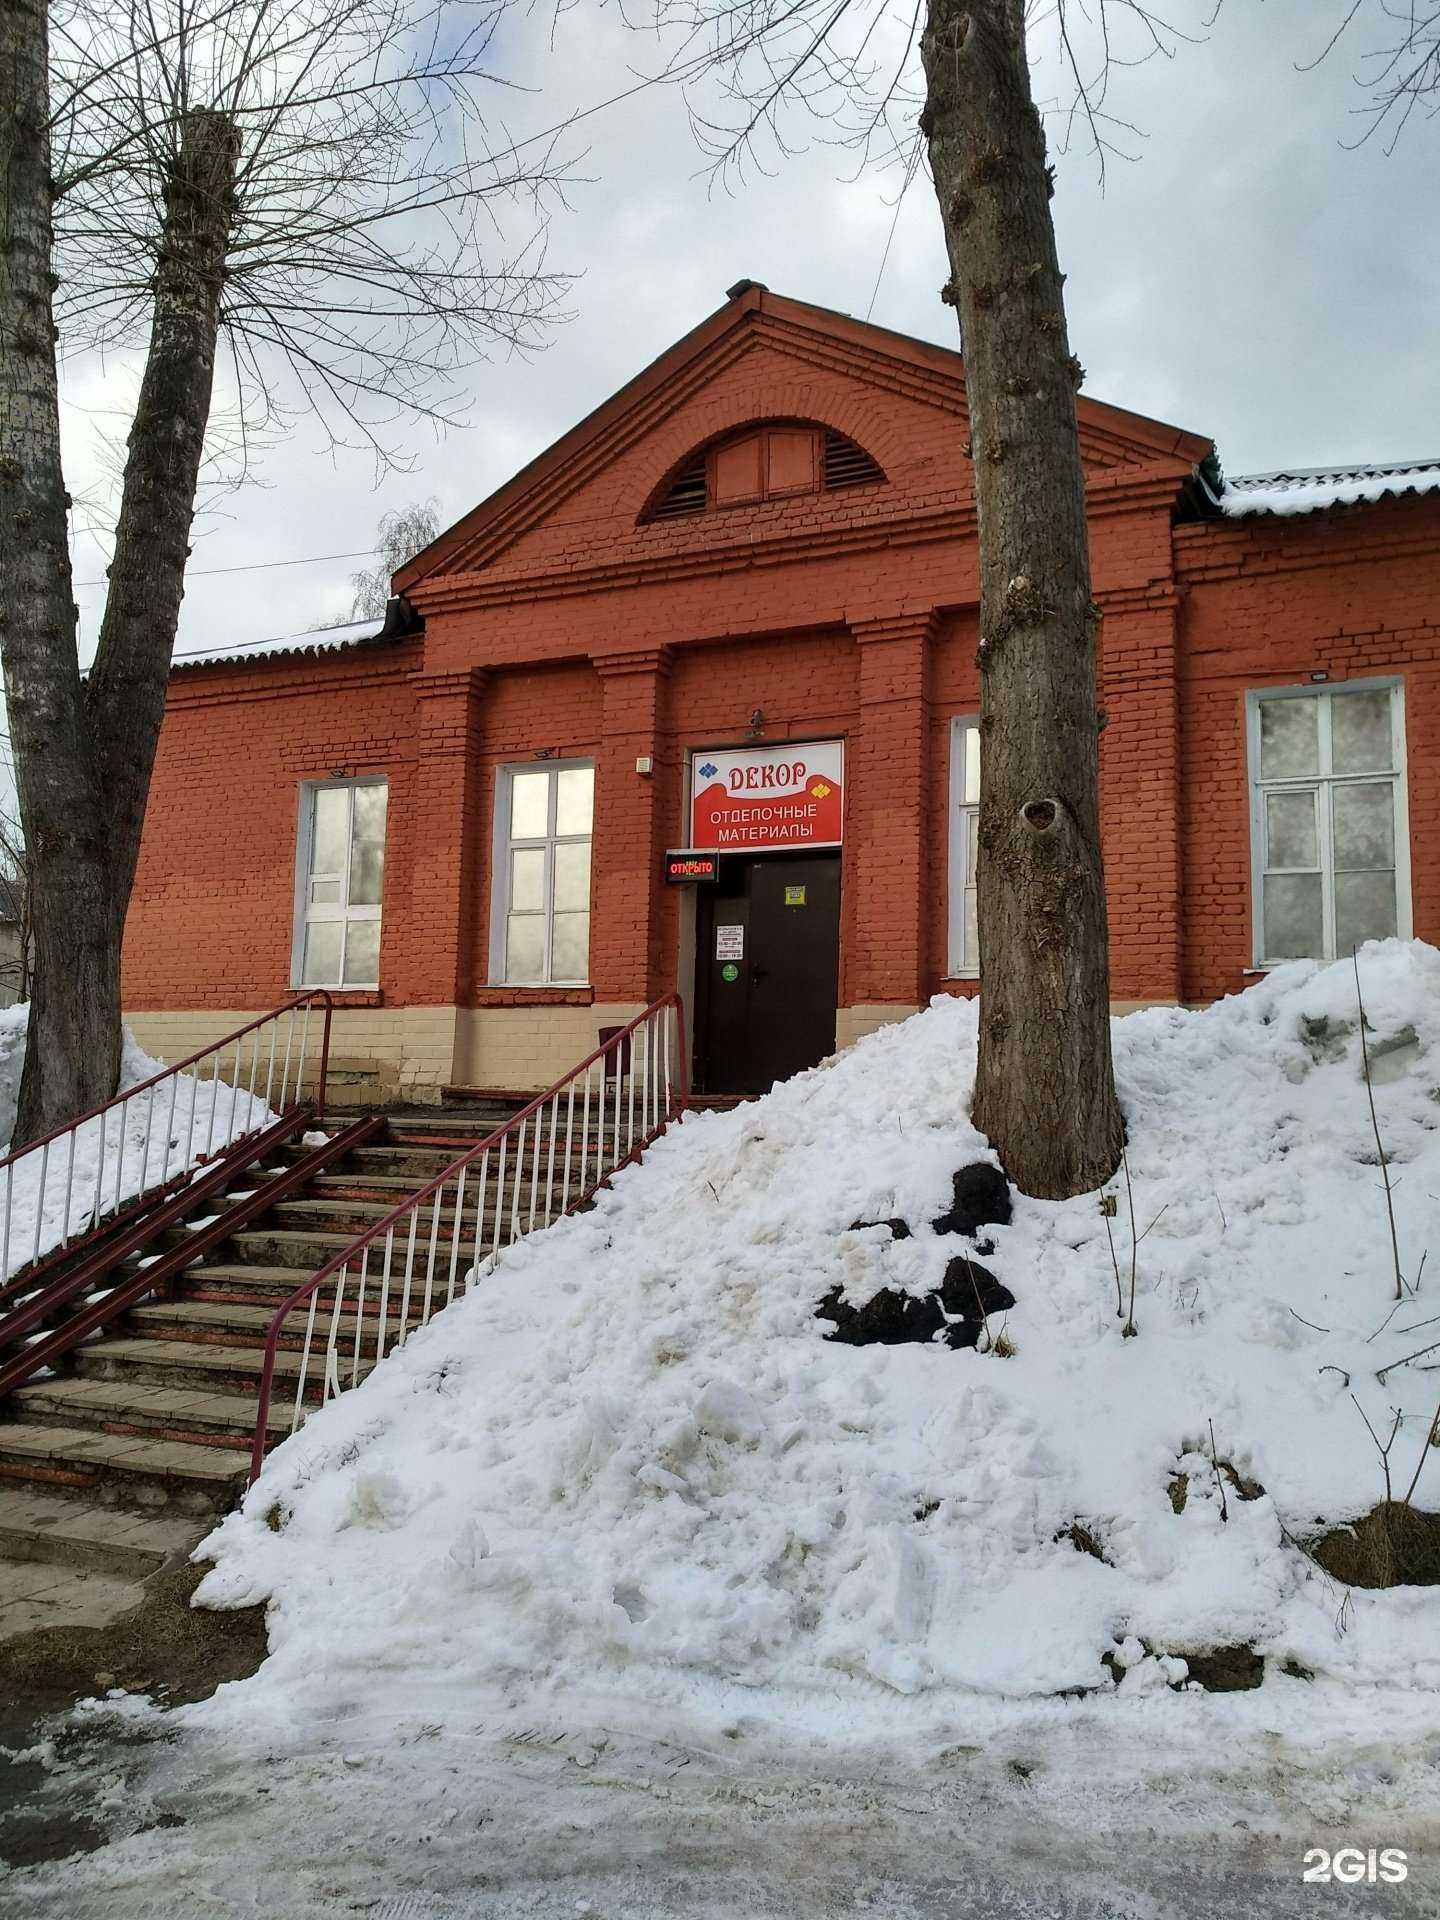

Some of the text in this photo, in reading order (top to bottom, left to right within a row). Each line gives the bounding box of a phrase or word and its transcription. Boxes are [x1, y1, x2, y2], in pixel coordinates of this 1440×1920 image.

[729, 761, 806, 790] ДЕКОР
[710, 804, 817, 824] ОТДЕЛОЧНЫЕ
[718, 824, 813, 842] МАТЕРИАЛЫ
[670, 862, 713, 873] ОТКРЫТО
